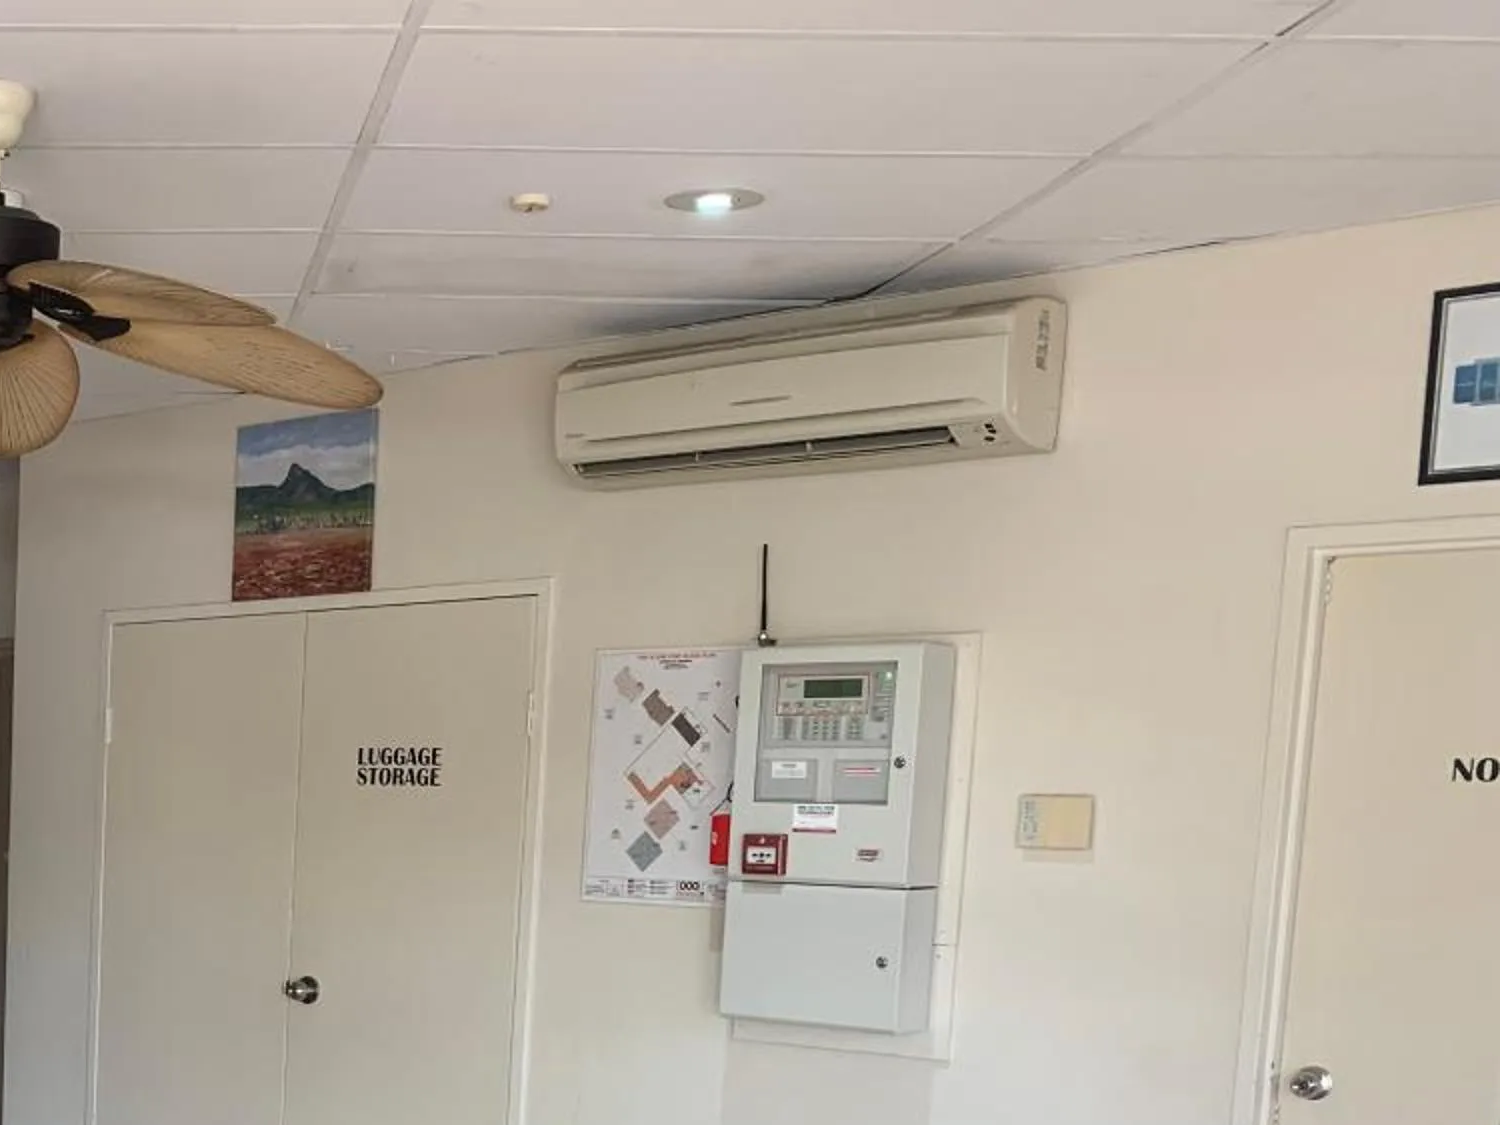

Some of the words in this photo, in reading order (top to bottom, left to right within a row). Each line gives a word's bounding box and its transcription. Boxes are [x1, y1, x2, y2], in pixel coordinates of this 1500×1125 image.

[357, 747, 443, 766] LUGGAGE
[356, 767, 442, 787] STORAGE
[1452, 757, 1500, 782] NO
